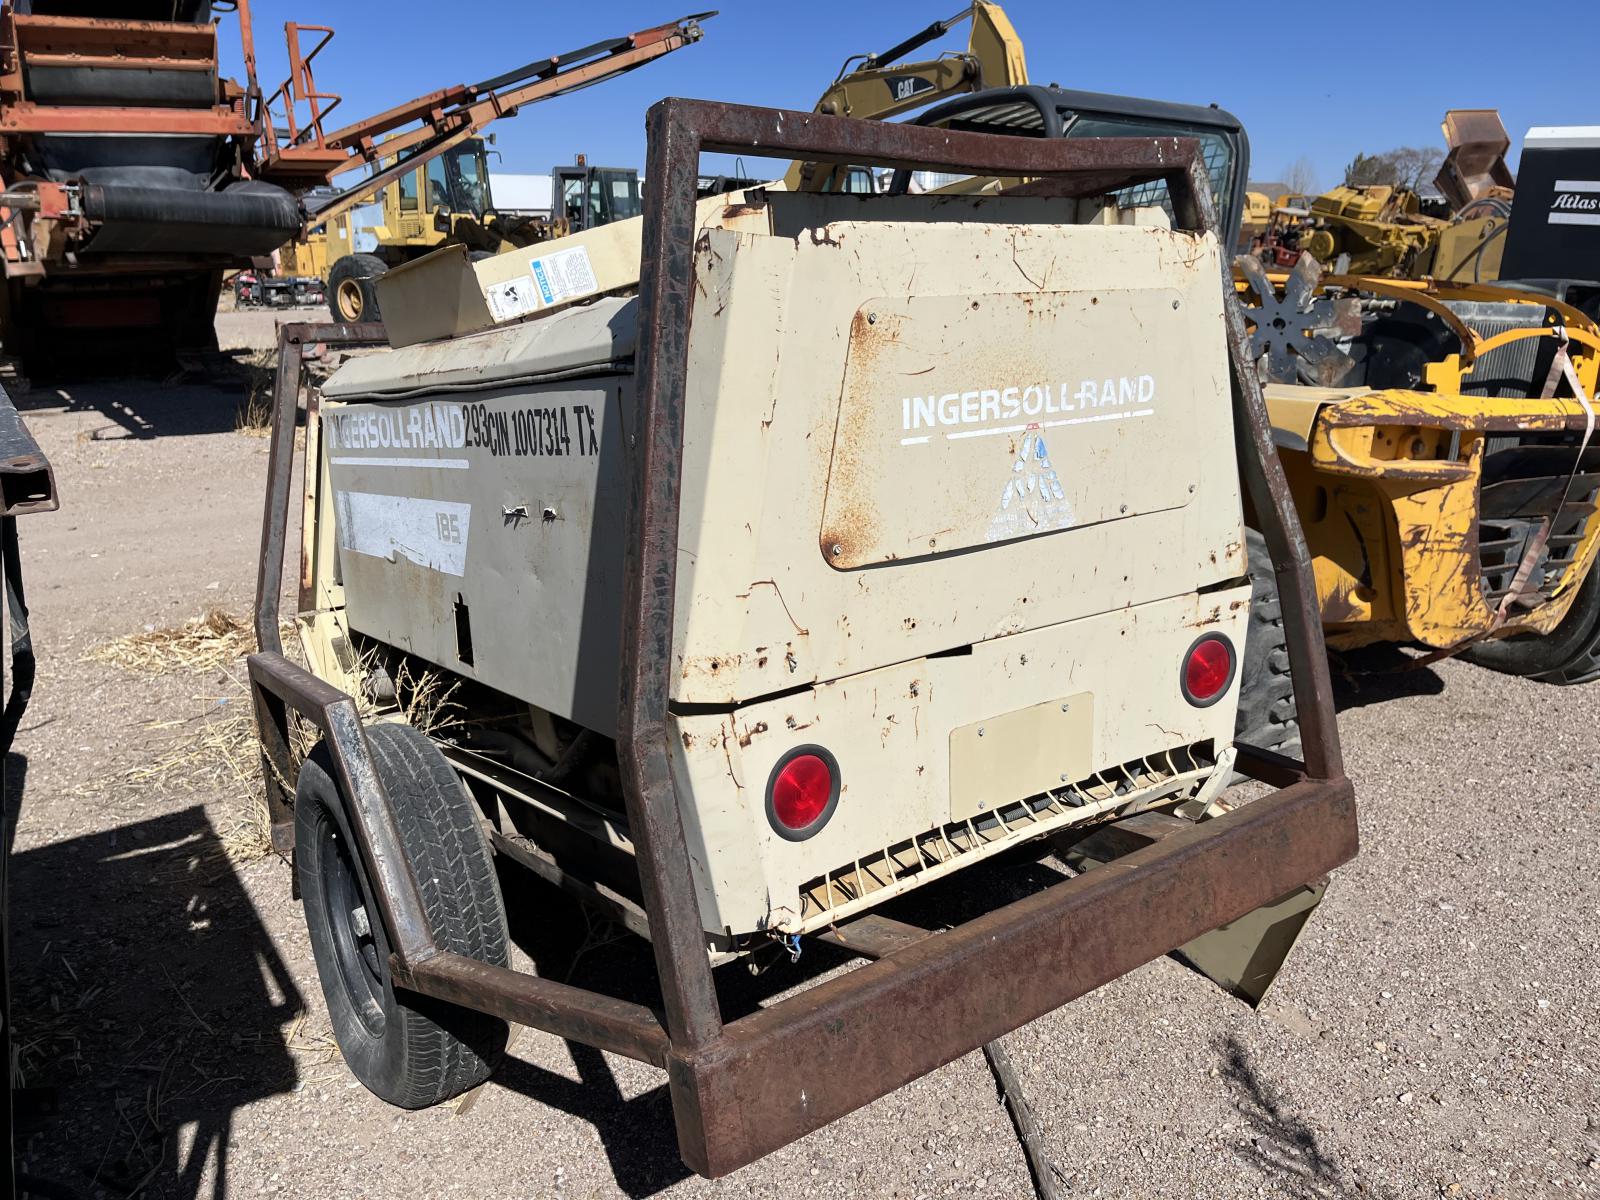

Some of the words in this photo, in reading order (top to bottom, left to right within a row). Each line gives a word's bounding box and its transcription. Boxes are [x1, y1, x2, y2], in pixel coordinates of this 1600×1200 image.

[897, 78, 915, 98] CAT
[1550, 193, 1597, 209] Atlas
[534, 265, 553, 301] NOTICE
[902, 374, 1155, 430] INGERSOLL-RAND
[511, 406, 571, 457] 1007314
[573, 404, 599, 457] TX
[435, 512, 462, 544] 185
